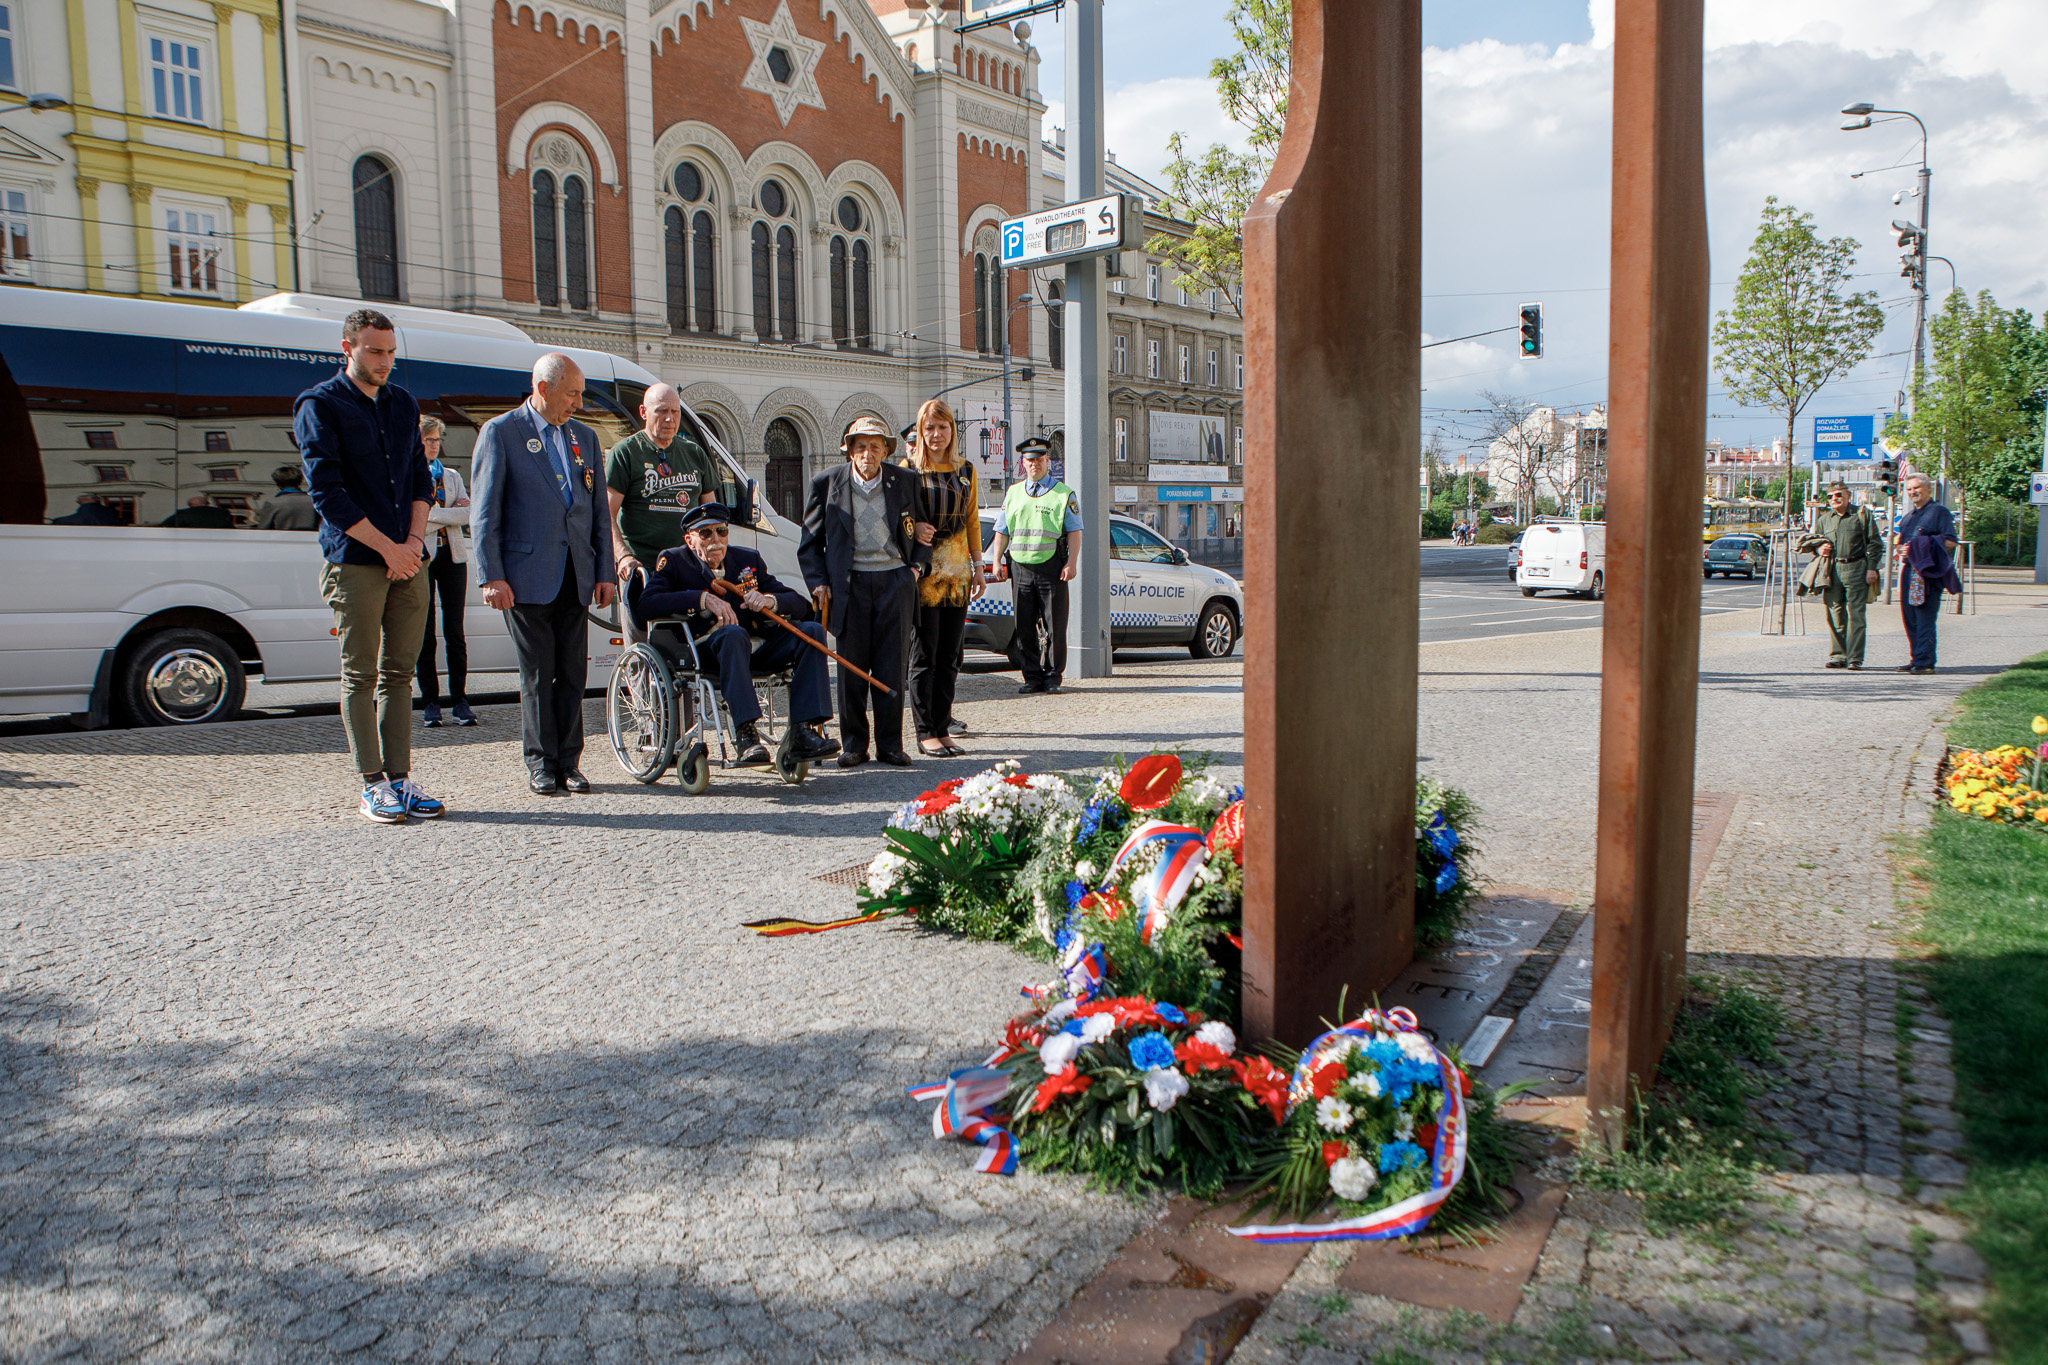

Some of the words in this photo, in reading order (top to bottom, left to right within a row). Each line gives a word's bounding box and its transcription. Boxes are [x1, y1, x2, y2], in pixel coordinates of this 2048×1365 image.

[1035, 207, 1086, 225] DIVADLO/THEATRE
[1024, 231, 1045, 242] VOLNO
[1008, 233, 1020, 257] P
[1026, 241, 1042, 250] FREE
[185, 344, 348, 365] www.minibusysed
[1174, 421, 1195, 430] REALITY
[1110, 582, 1136, 597] SKÁ
[1139, 585, 1185, 598] POLICIE
[1158, 613, 1184, 623] PLZEŇ
